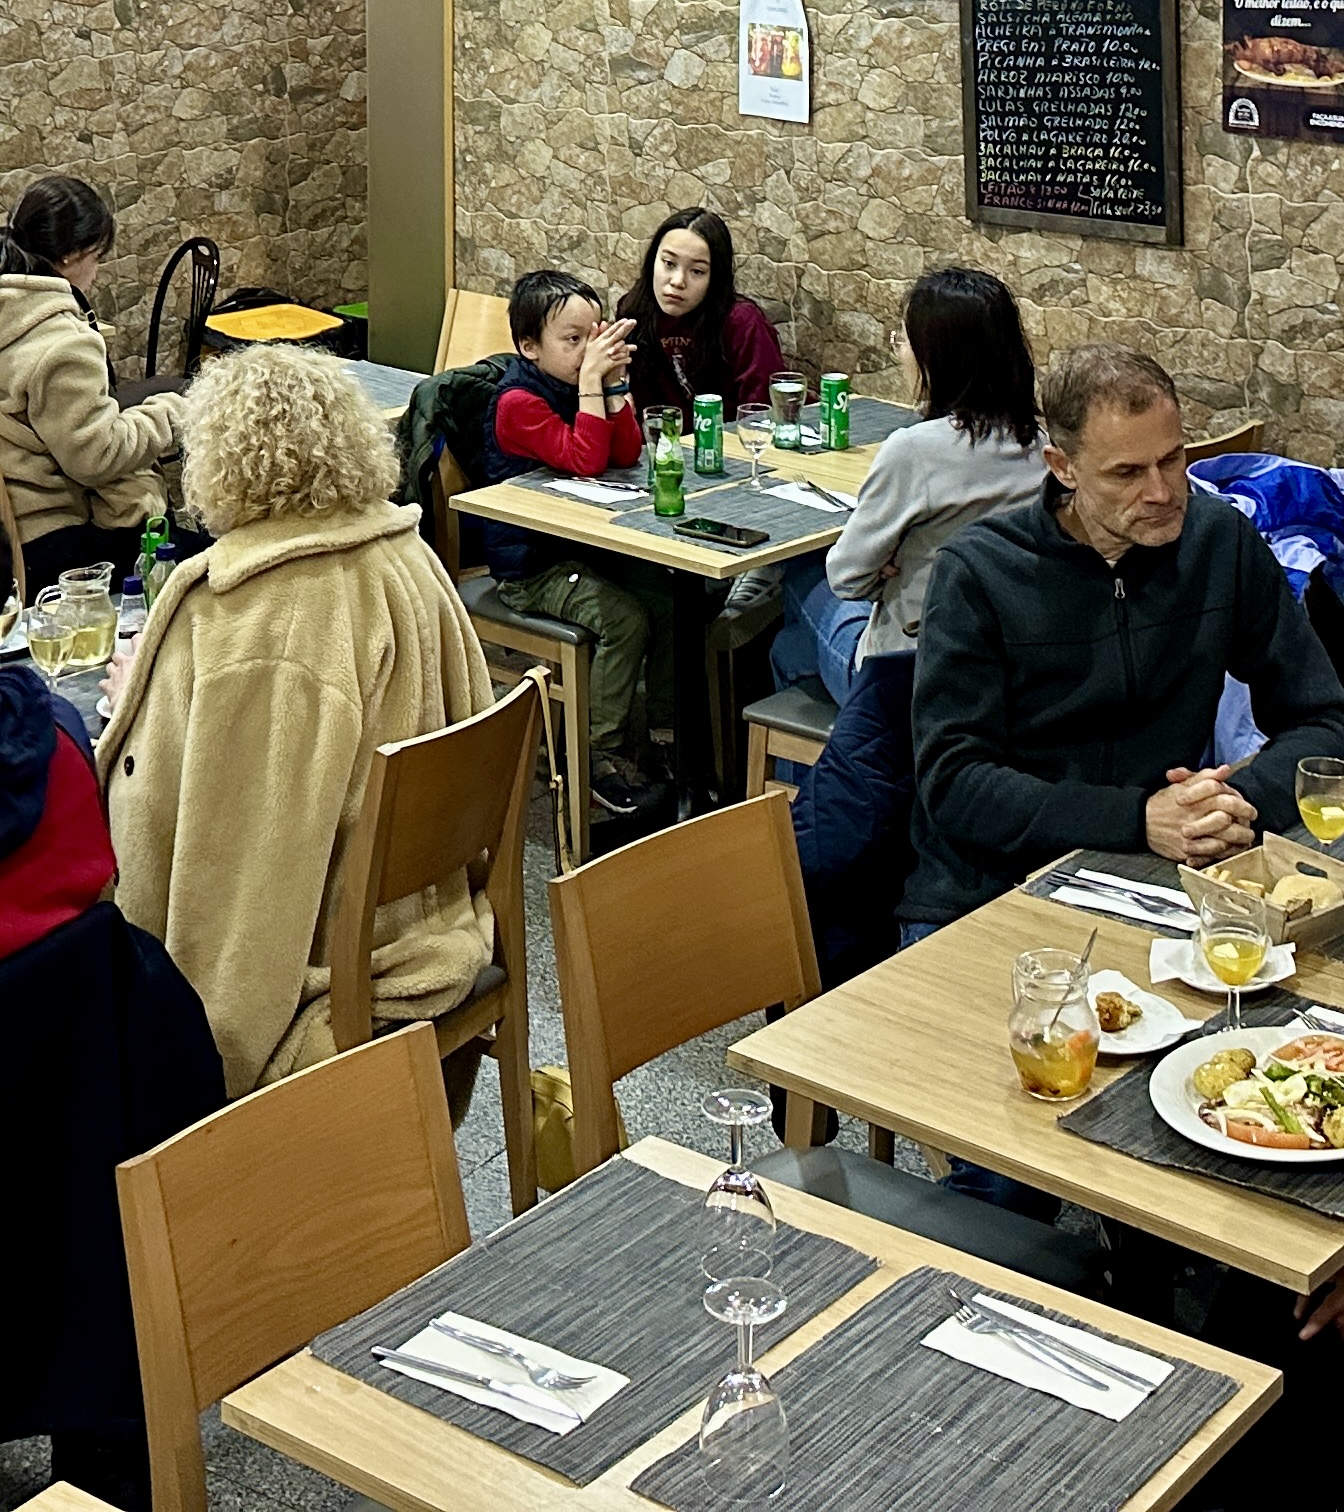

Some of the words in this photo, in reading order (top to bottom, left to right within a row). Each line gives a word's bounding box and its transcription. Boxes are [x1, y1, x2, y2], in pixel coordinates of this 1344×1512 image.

[1321, 0, 1328, 9] o
[977, 11, 1051, 25] SALSICHA
[975, 24, 1043, 39] ALHEIRA
[976, 39, 1017, 53] PREGO
[1053, 38, 1096, 53] PRATO
[978, 53, 1045, 69] PICANHA
[977, 69, 1028, 85] ARROZ
[1034, 71, 1100, 85] MARISCO
[978, 85, 1053, 99] SARDINHAS
[1059, 86, 1116, 100] ASSADAS
[979, 100, 1025, 113] LULAS
[1033, 101, 1113, 117] GRELHADAS
[1043, 115, 1109, 130] GRELHADO
[979, 127, 1017, 142] POLVO
[978, 142, 1045, 156] BACALHAU
[1061, 145, 1104, 157] BRAGA
[979, 156, 1043, 170] BACALHAU
[1056, 172, 1099, 185] NATAS
[980, 181, 1026, 195] LEITÃO
